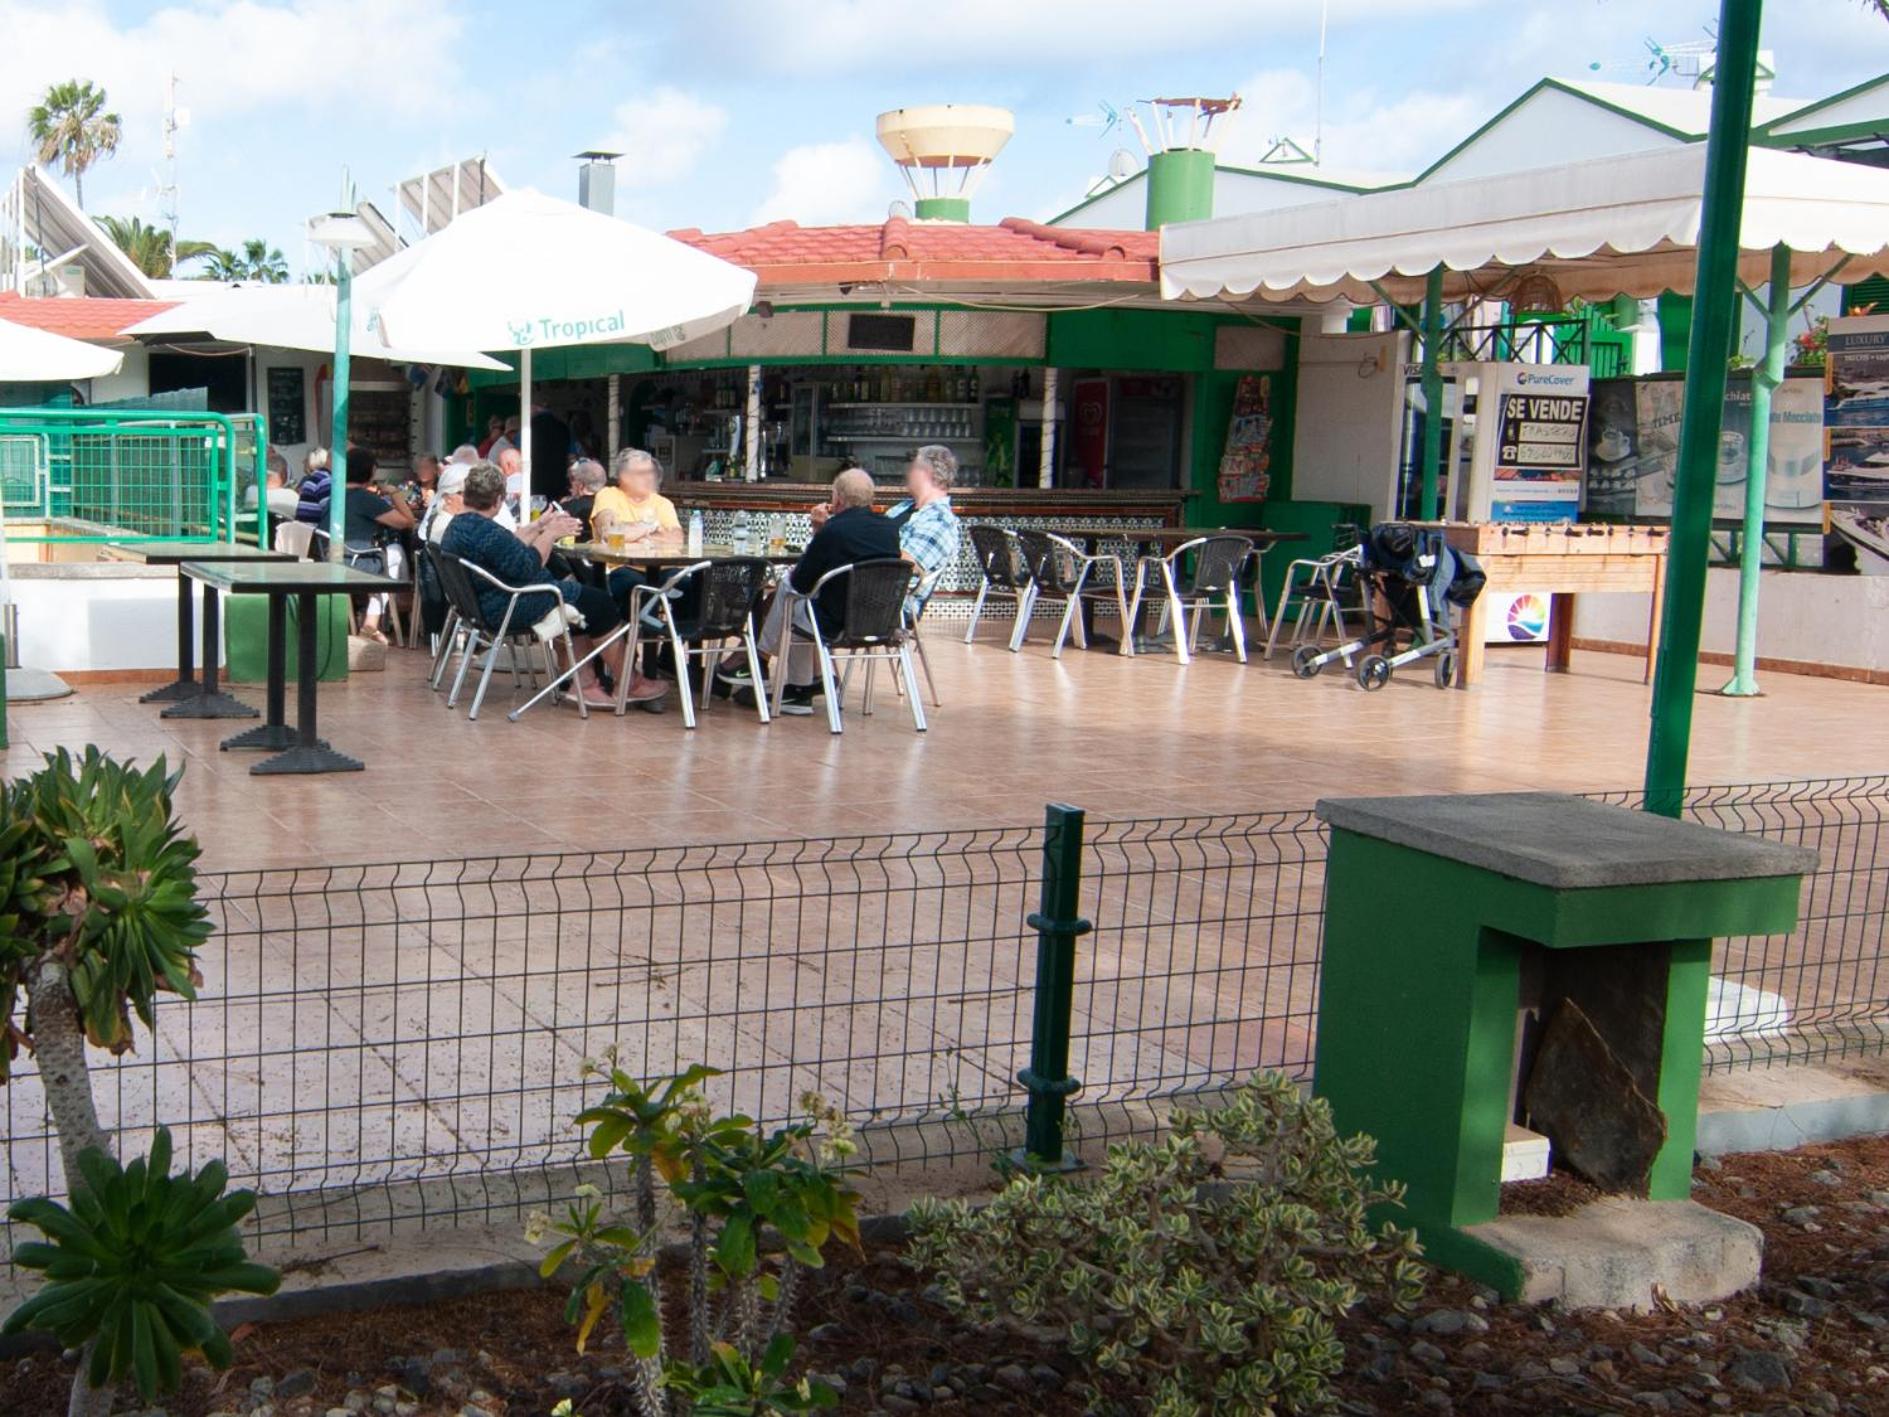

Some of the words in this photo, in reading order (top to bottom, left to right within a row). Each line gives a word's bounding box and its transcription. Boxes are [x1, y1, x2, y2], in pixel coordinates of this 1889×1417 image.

[538, 309, 624, 339] Tropical
[1528, 373, 1575, 385] PureCover
[1507, 398, 1525, 418] SE
[1529, 399, 1583, 421] VENDE
